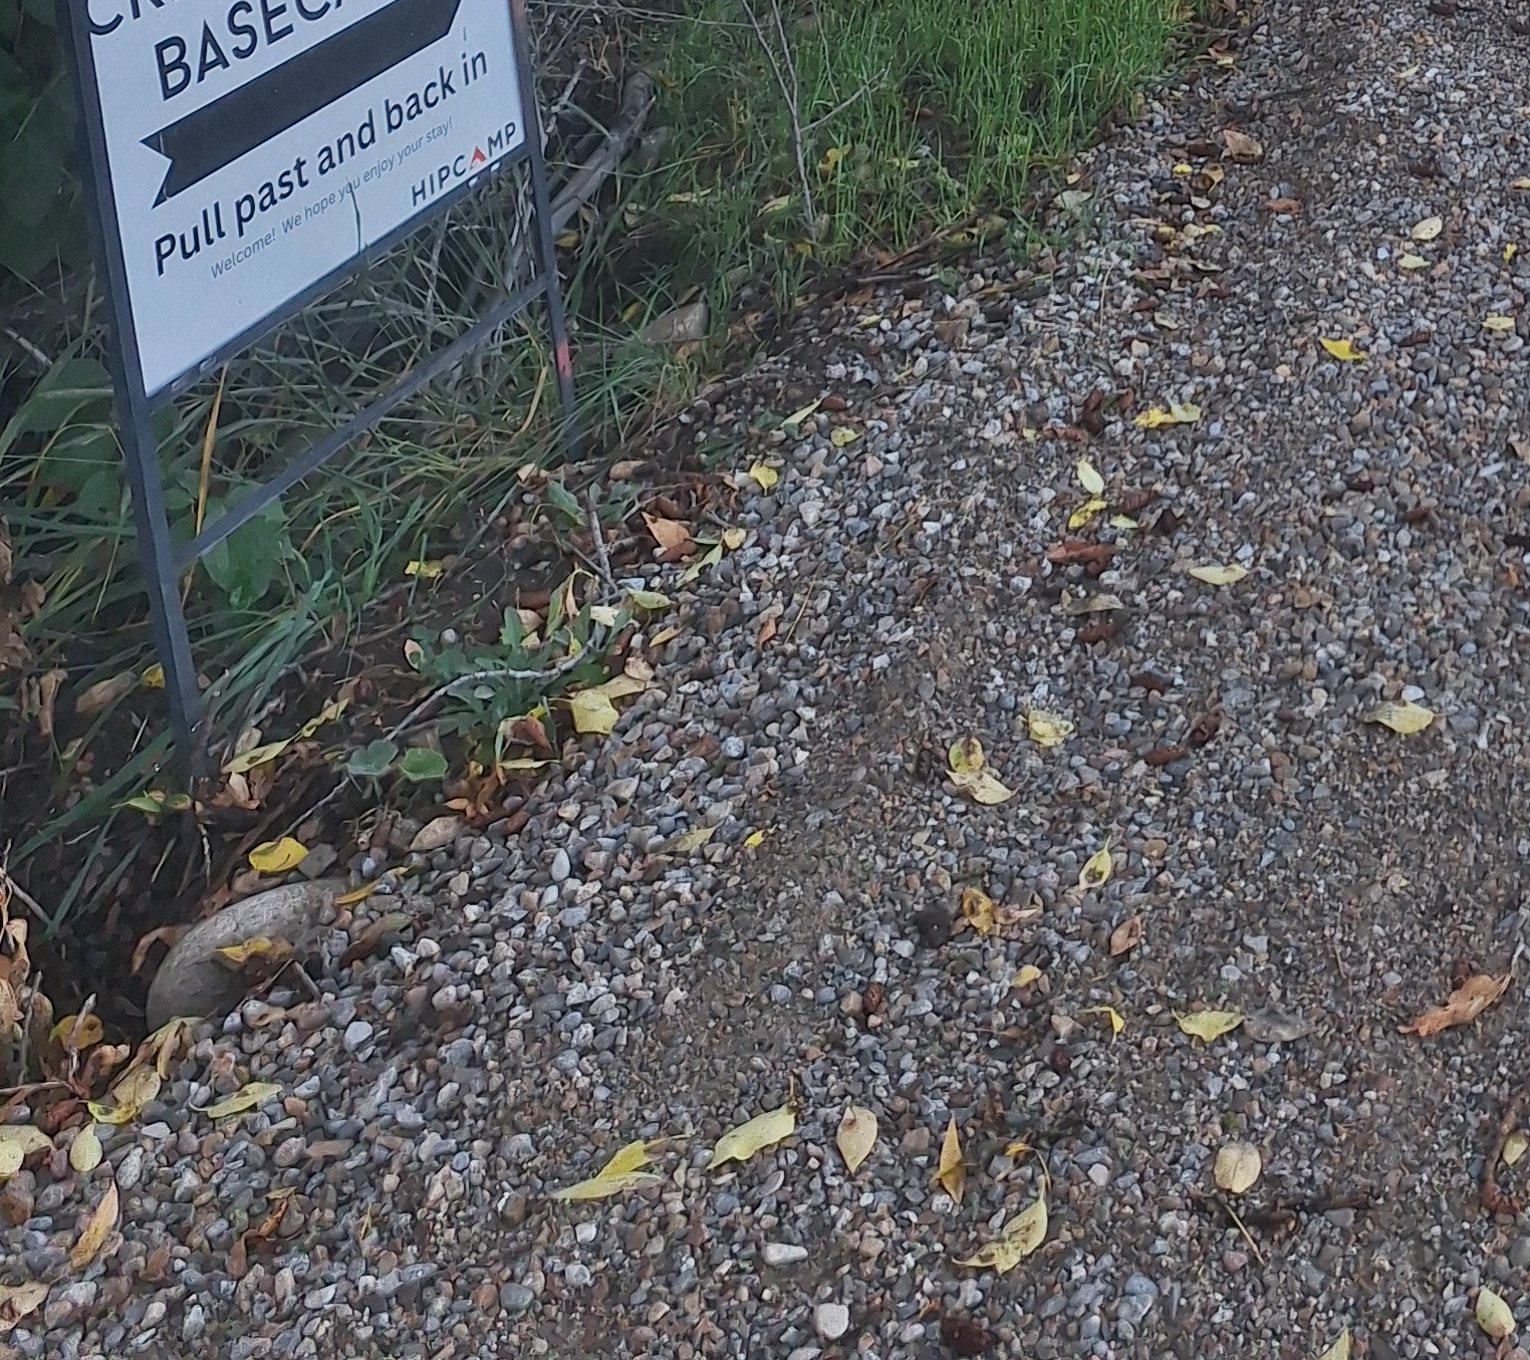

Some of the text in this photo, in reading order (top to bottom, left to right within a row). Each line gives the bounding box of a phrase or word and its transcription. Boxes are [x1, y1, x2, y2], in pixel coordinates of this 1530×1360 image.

[154, 49, 488, 277] Pull past and back in
[210, 116, 454, 280] Welcome! We hope you enjoy your stay!
[410, 121, 517, 207] HIPCAMP
